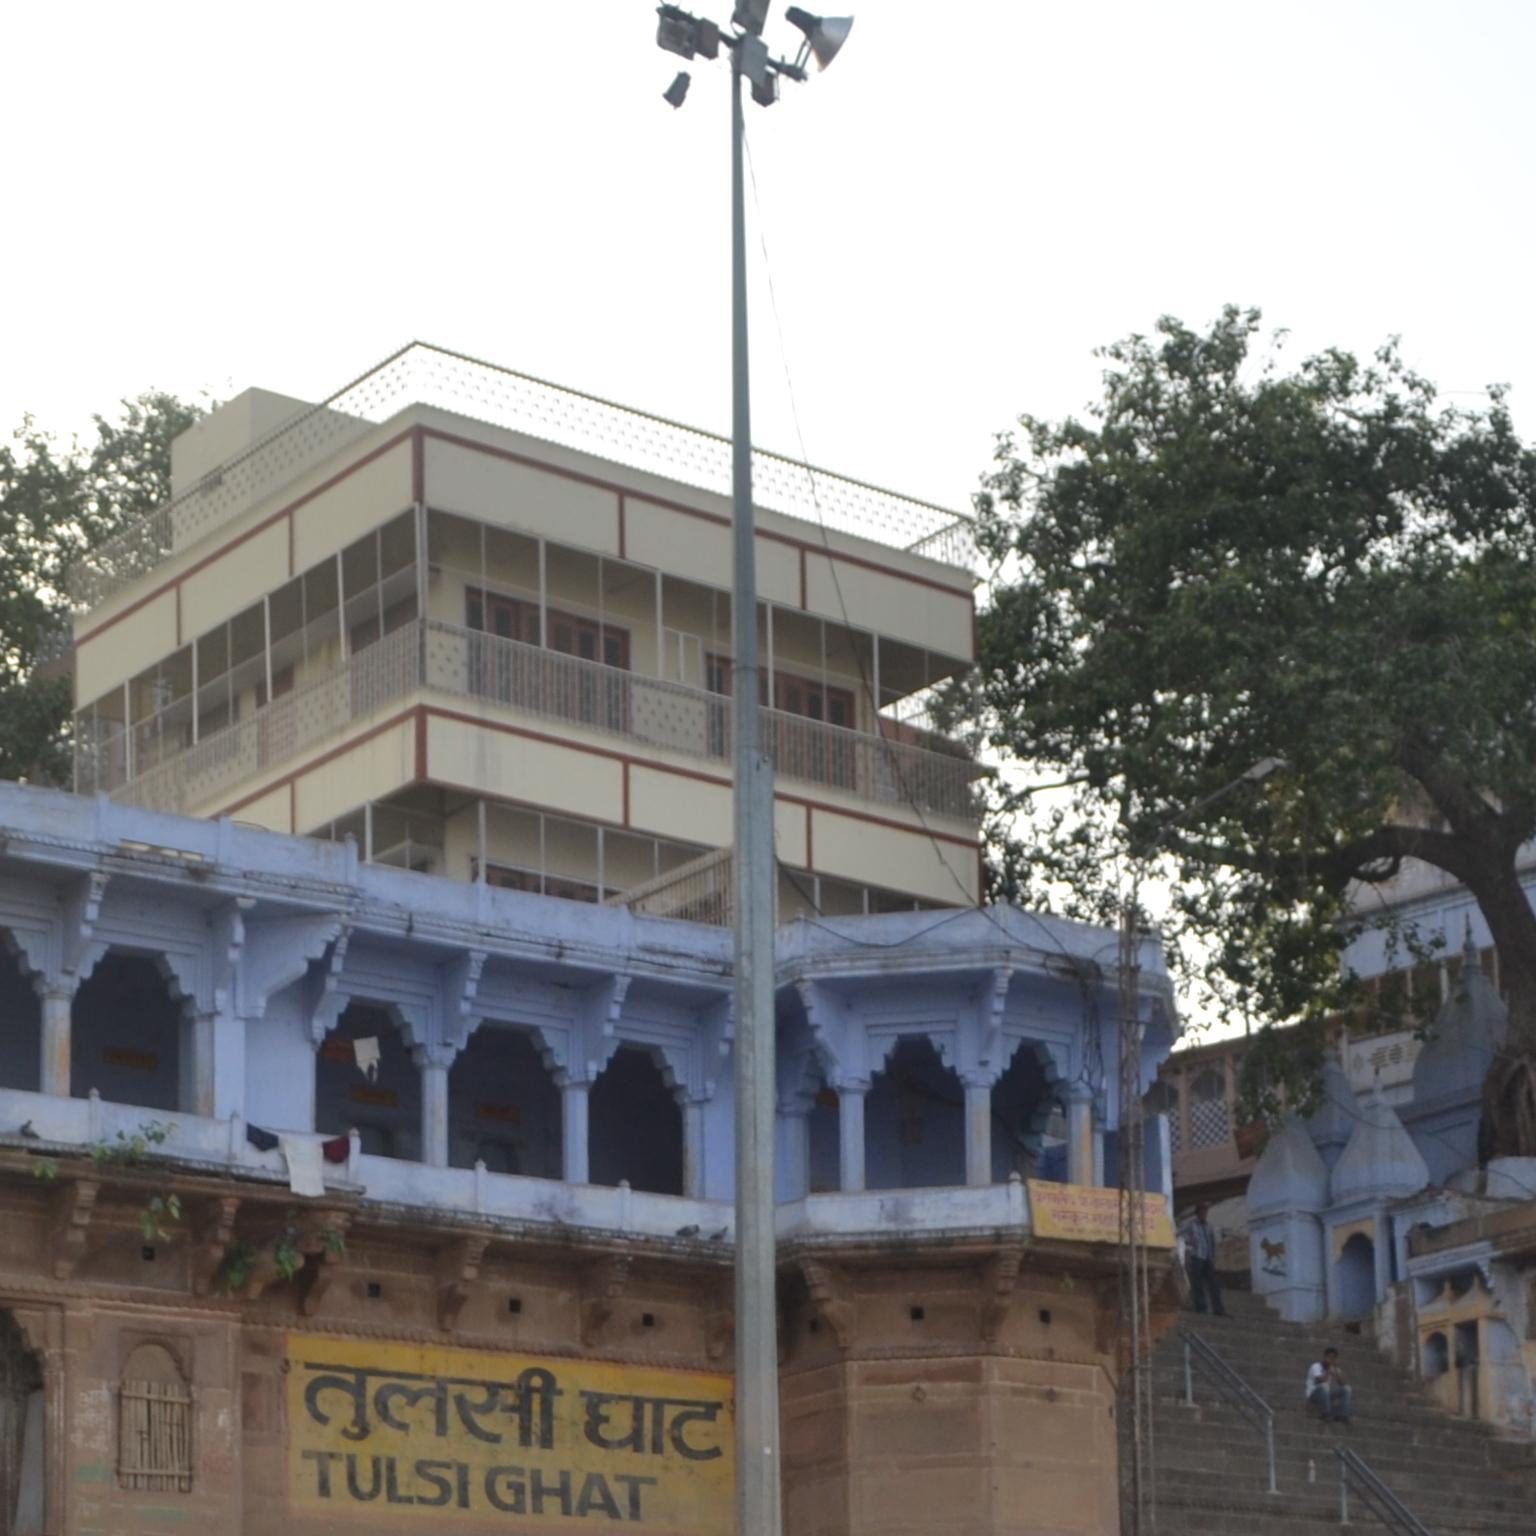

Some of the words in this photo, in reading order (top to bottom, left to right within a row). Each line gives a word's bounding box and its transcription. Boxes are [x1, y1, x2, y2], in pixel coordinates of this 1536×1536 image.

[303, 1361, 562, 1450] तुलसी
[579, 1389, 723, 1460] घाट
[301, 1449, 470, 1509] TULSI
[484, 1465, 658, 1522] GHAT
